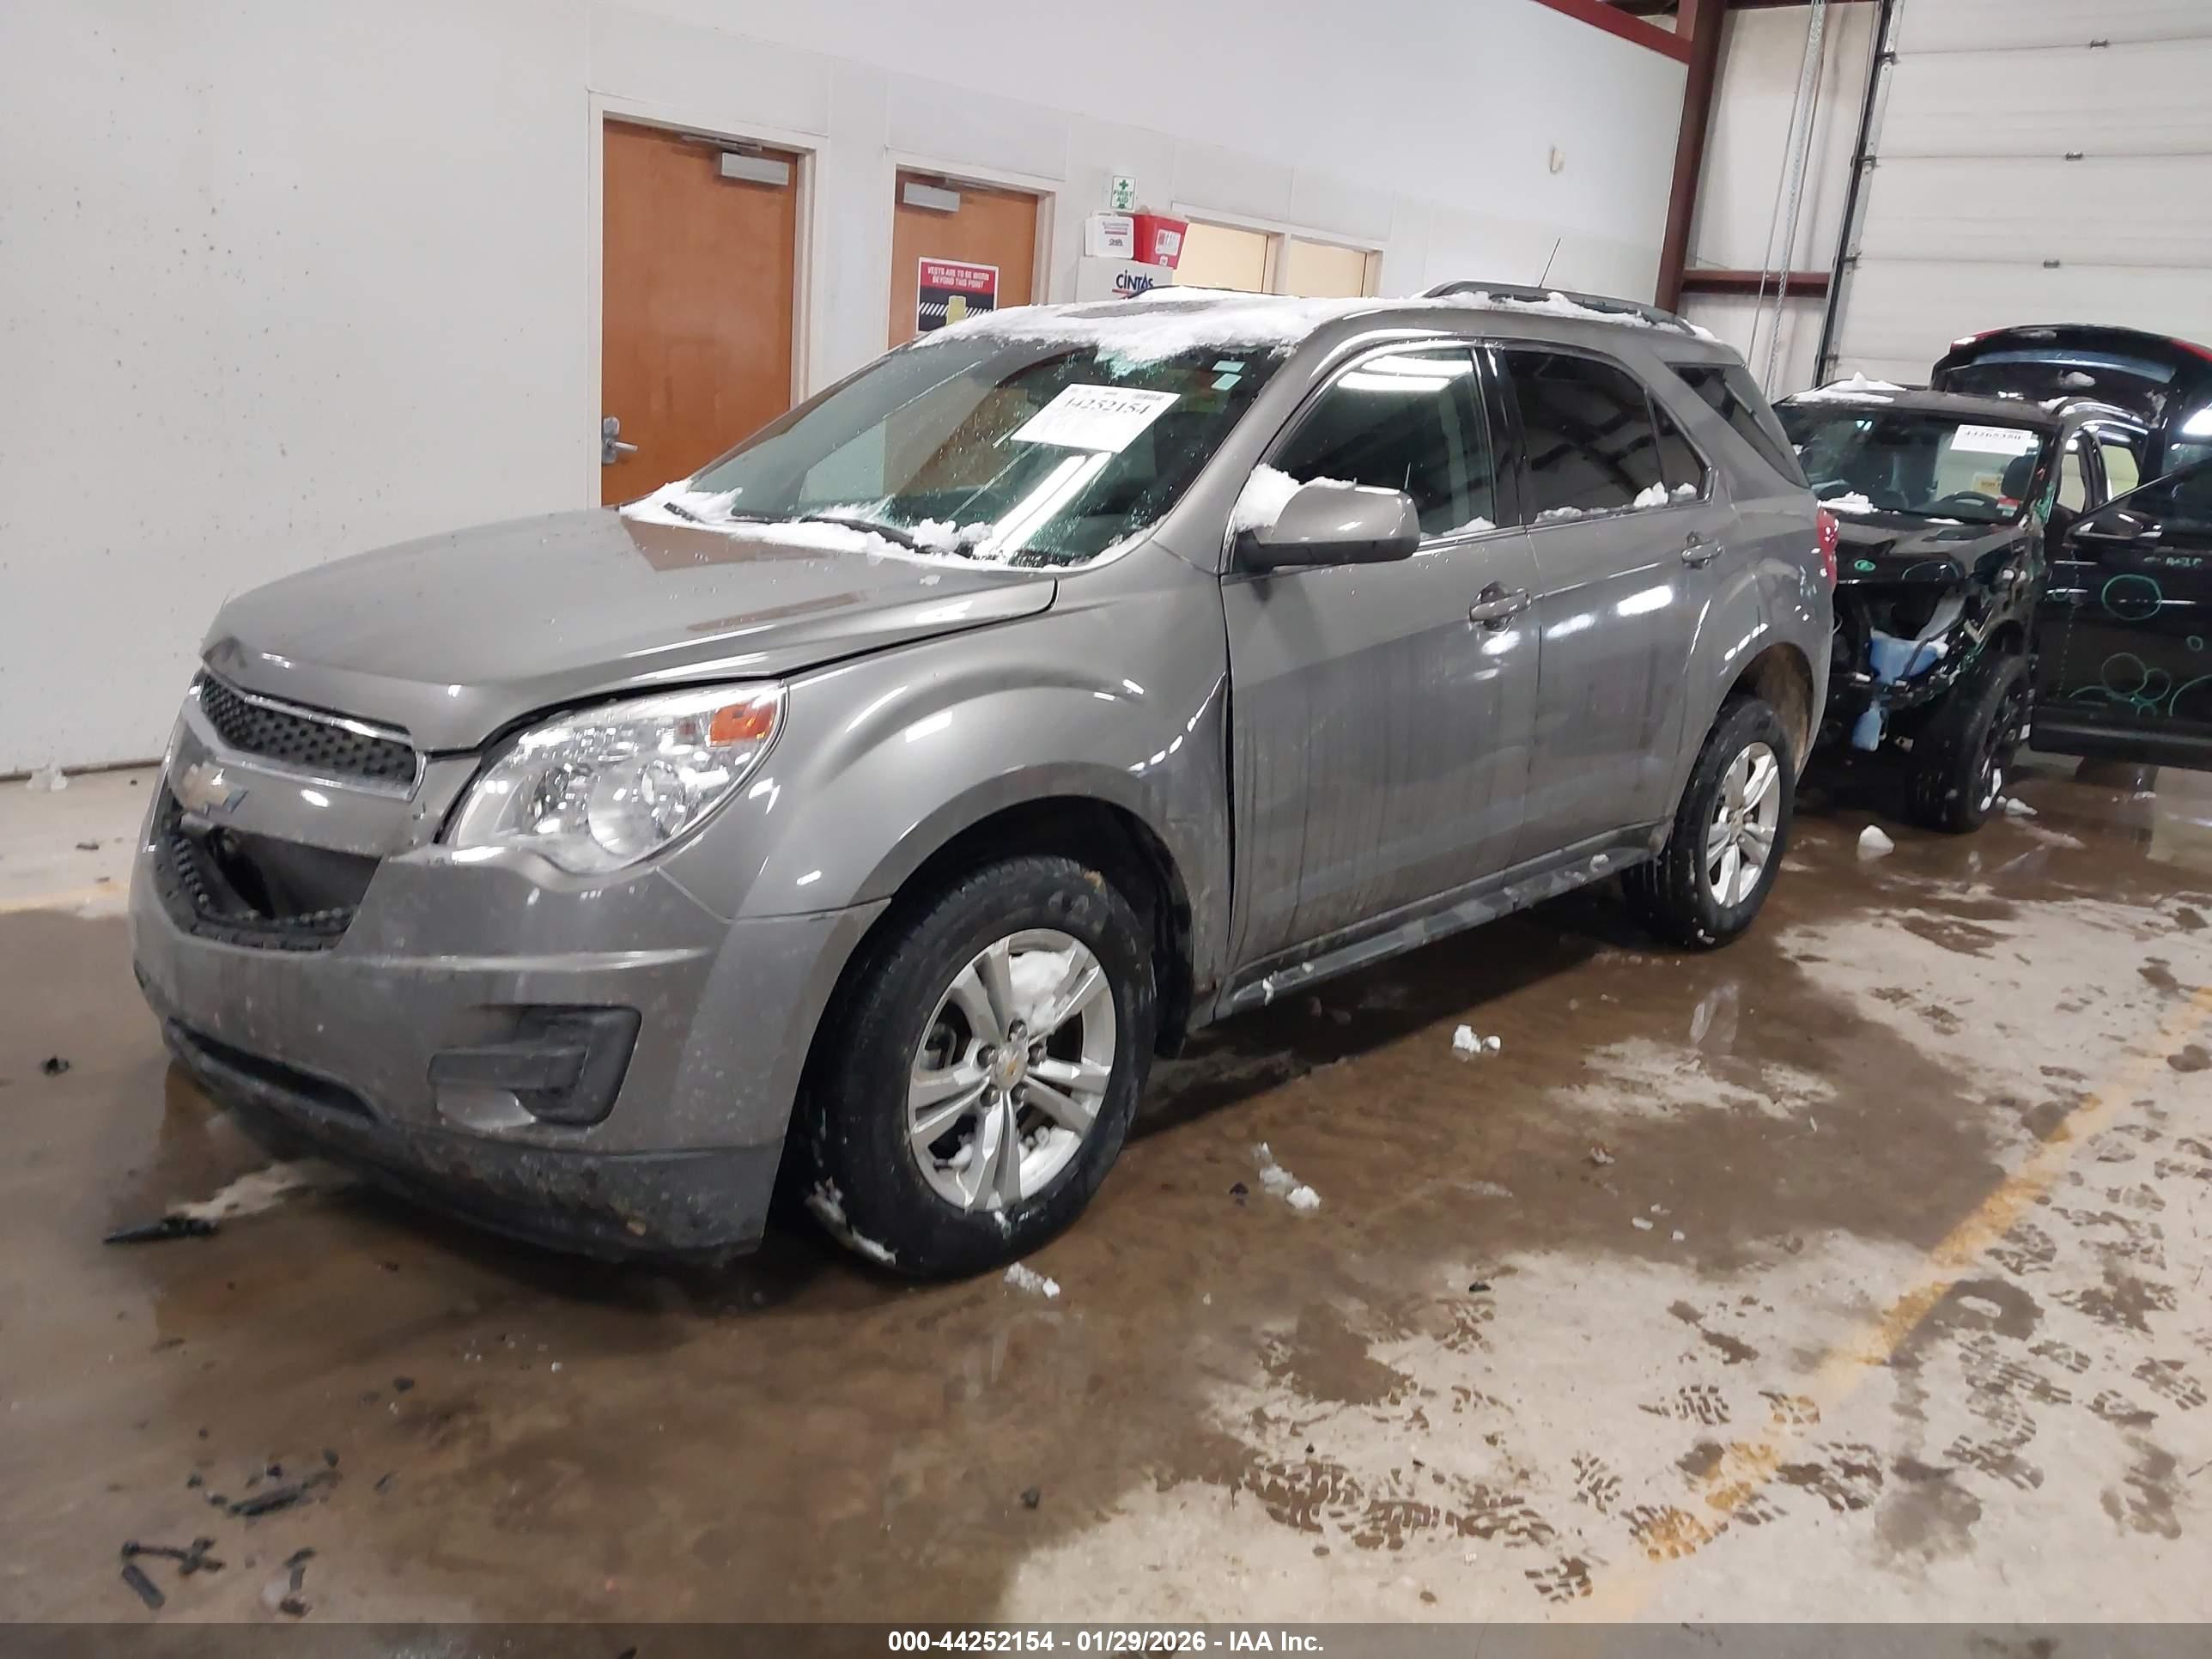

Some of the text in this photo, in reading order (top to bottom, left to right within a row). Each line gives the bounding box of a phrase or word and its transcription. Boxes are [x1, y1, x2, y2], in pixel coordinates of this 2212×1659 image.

[957, 270, 964, 278] TO
[1115, 269, 1154, 290] CINTAS
[956, 277, 967, 286] THIS
[968, 279, 984, 289] POINT
